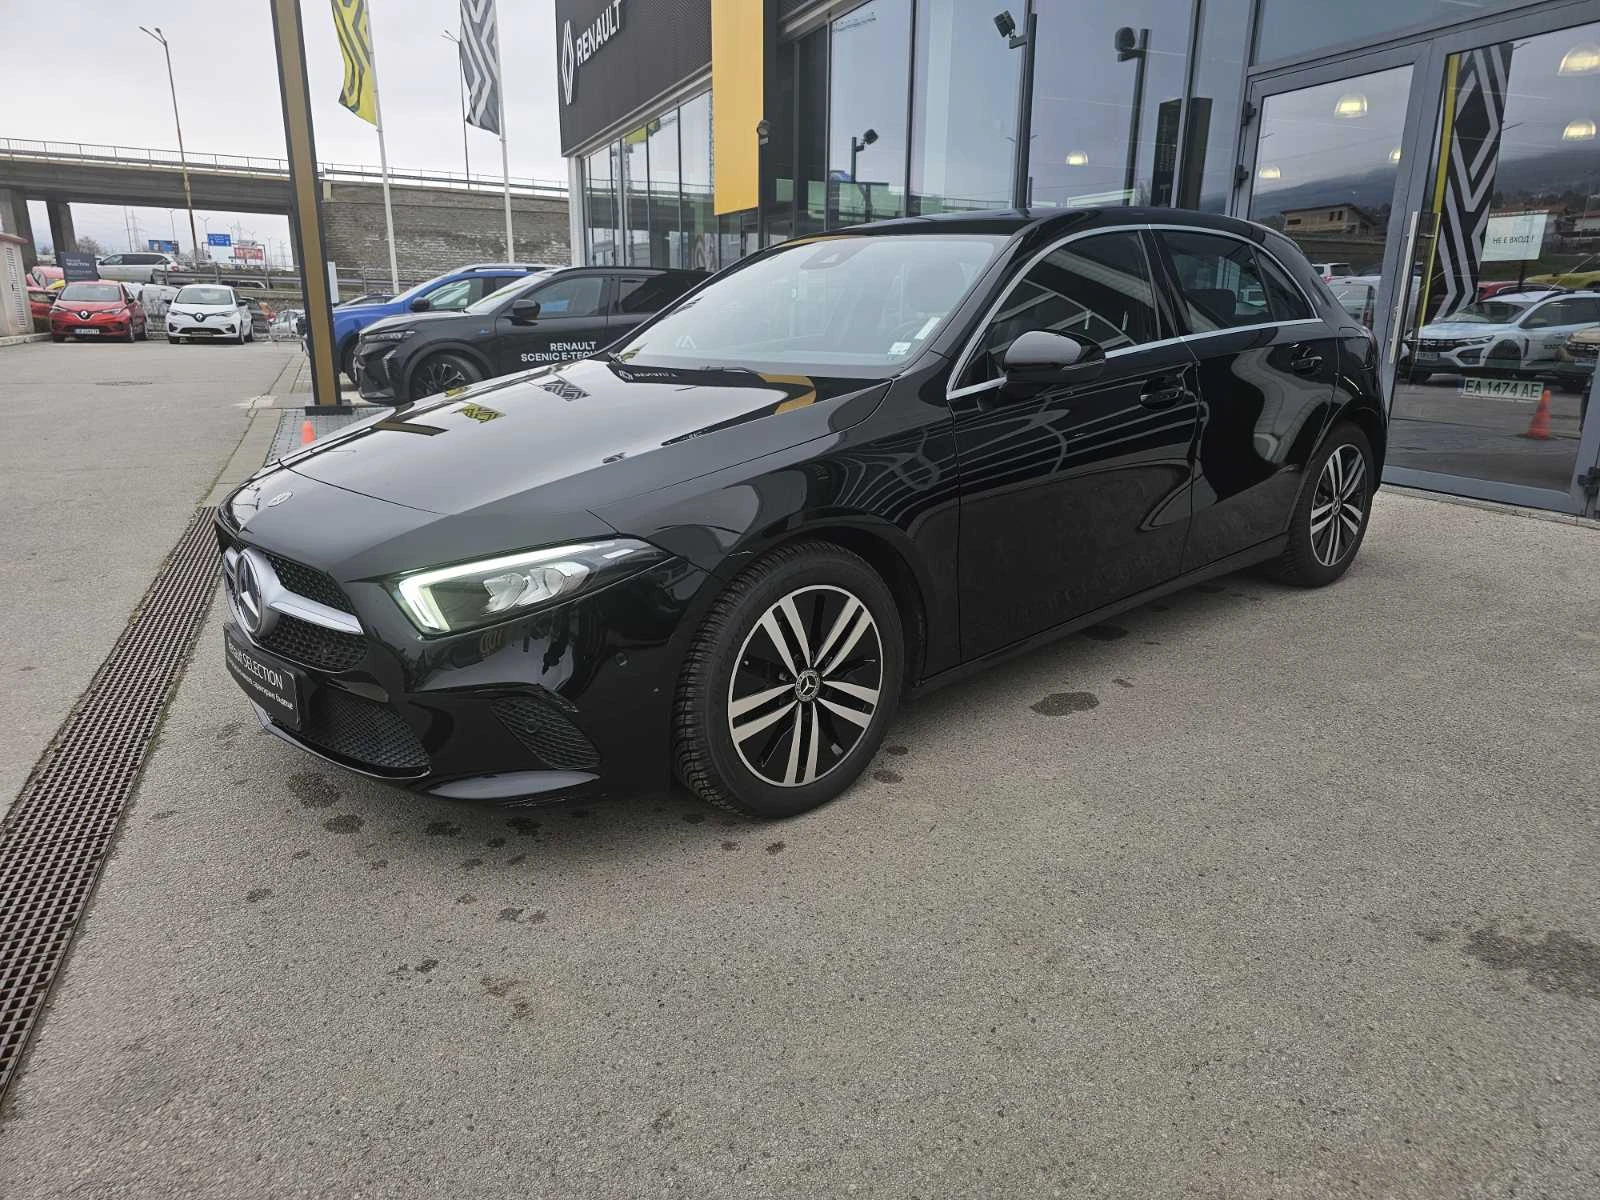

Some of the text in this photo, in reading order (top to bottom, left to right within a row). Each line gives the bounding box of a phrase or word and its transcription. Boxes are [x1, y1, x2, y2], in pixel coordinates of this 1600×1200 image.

[576, 0, 622, 67] RENAULT
[549, 341, 597, 352] RENAULT
[520, 352, 560, 362] SCENIC
[1464, 379, 1541, 398] EA 1474 AE
[242, 652, 284, 691] SELECTION
